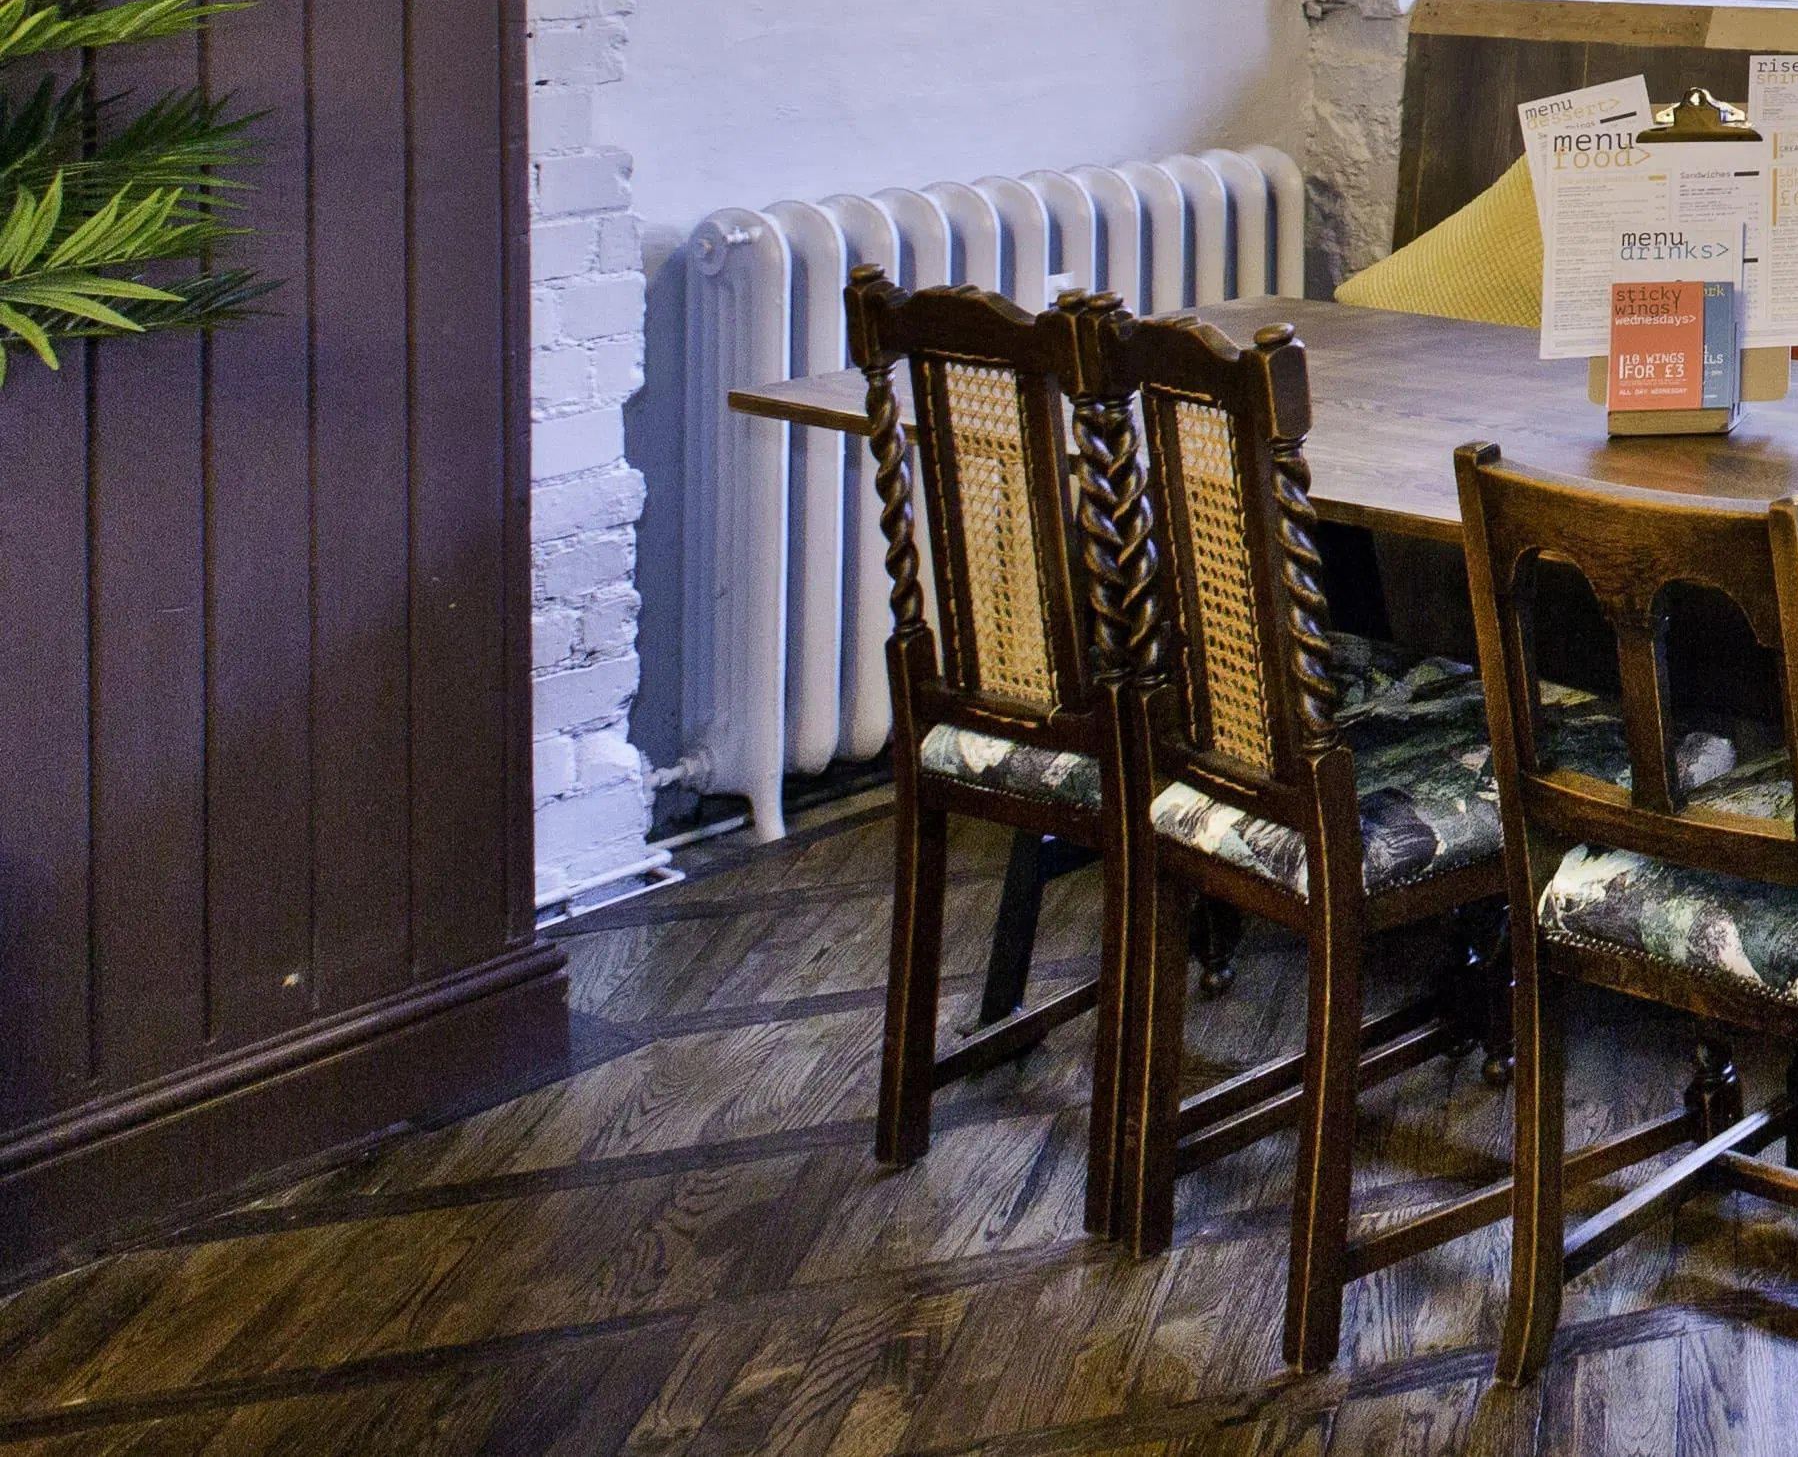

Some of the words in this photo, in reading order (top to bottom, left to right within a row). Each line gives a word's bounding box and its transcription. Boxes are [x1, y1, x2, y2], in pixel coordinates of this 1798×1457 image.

[1525, 98, 1574, 120] menu
[1553, 132, 1635, 153] menu
[1680, 171, 1731, 179] Sandwiches
[1621, 229, 1686, 247] menu
[1616, 285, 1682, 303] sticky
[1615, 301, 1679, 318] wings!
[1625, 353, 1640, 364] 10
[1645, 352, 1685, 364] WINGS
[1625, 365, 1655, 379] FOR
[1665, 364, 1684, 378] £3
